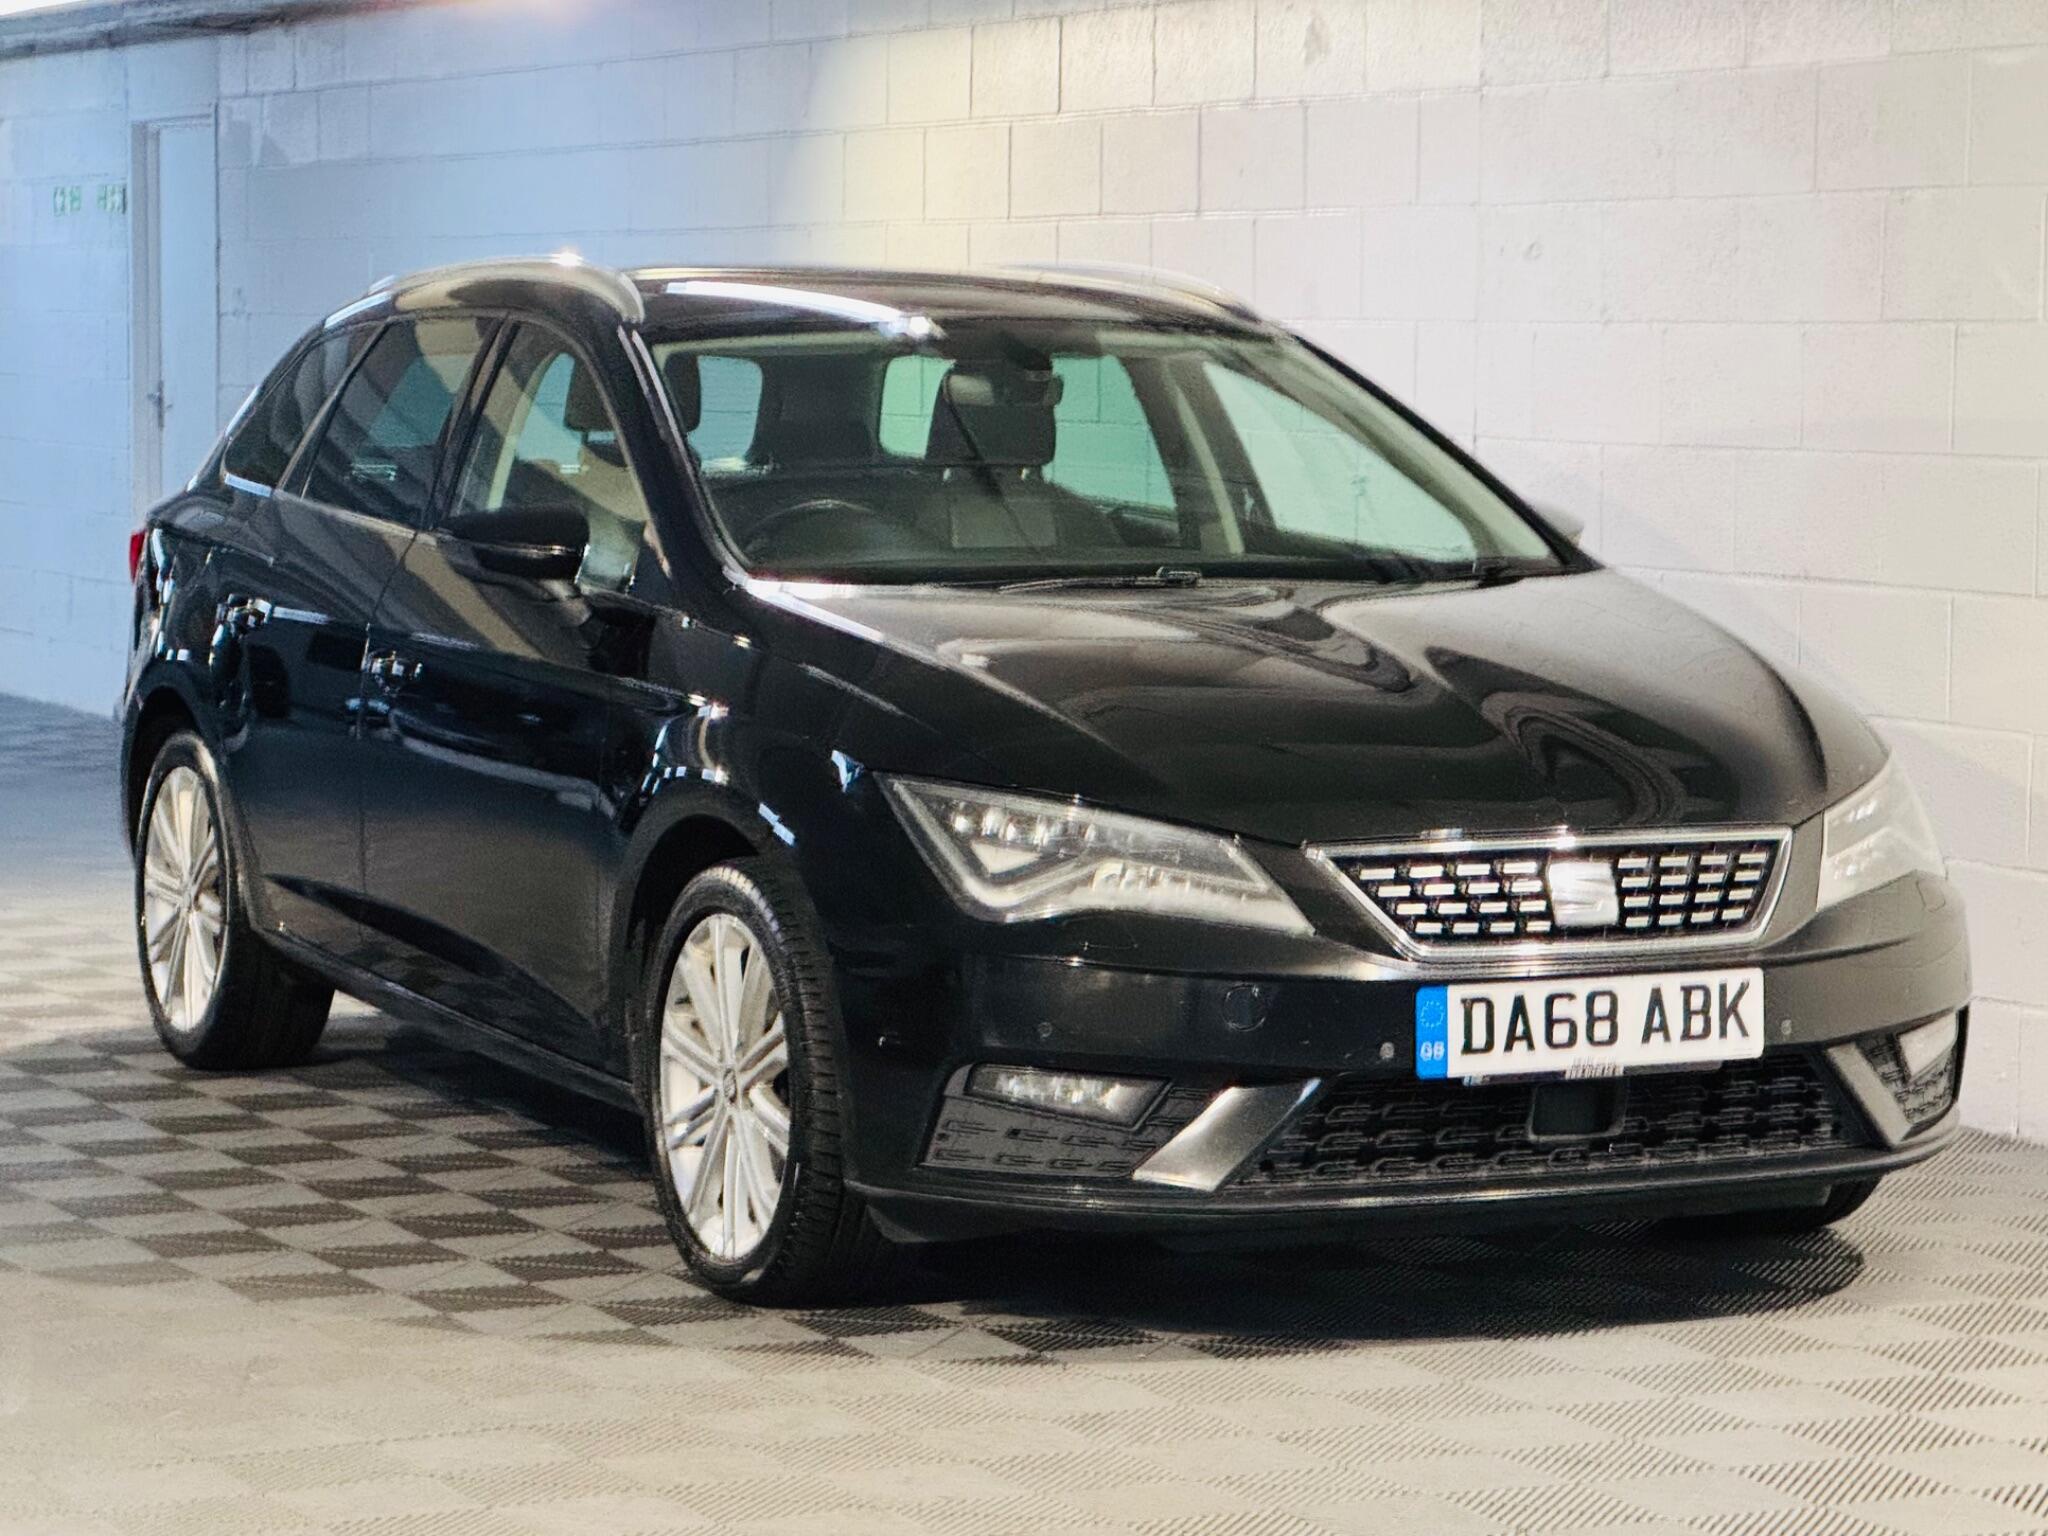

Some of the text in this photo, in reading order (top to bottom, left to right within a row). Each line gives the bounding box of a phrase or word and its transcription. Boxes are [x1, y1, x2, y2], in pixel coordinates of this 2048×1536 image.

[1460, 978, 1752, 1055] DA68 ABK
[1419, 1040, 1445, 1061] GB
